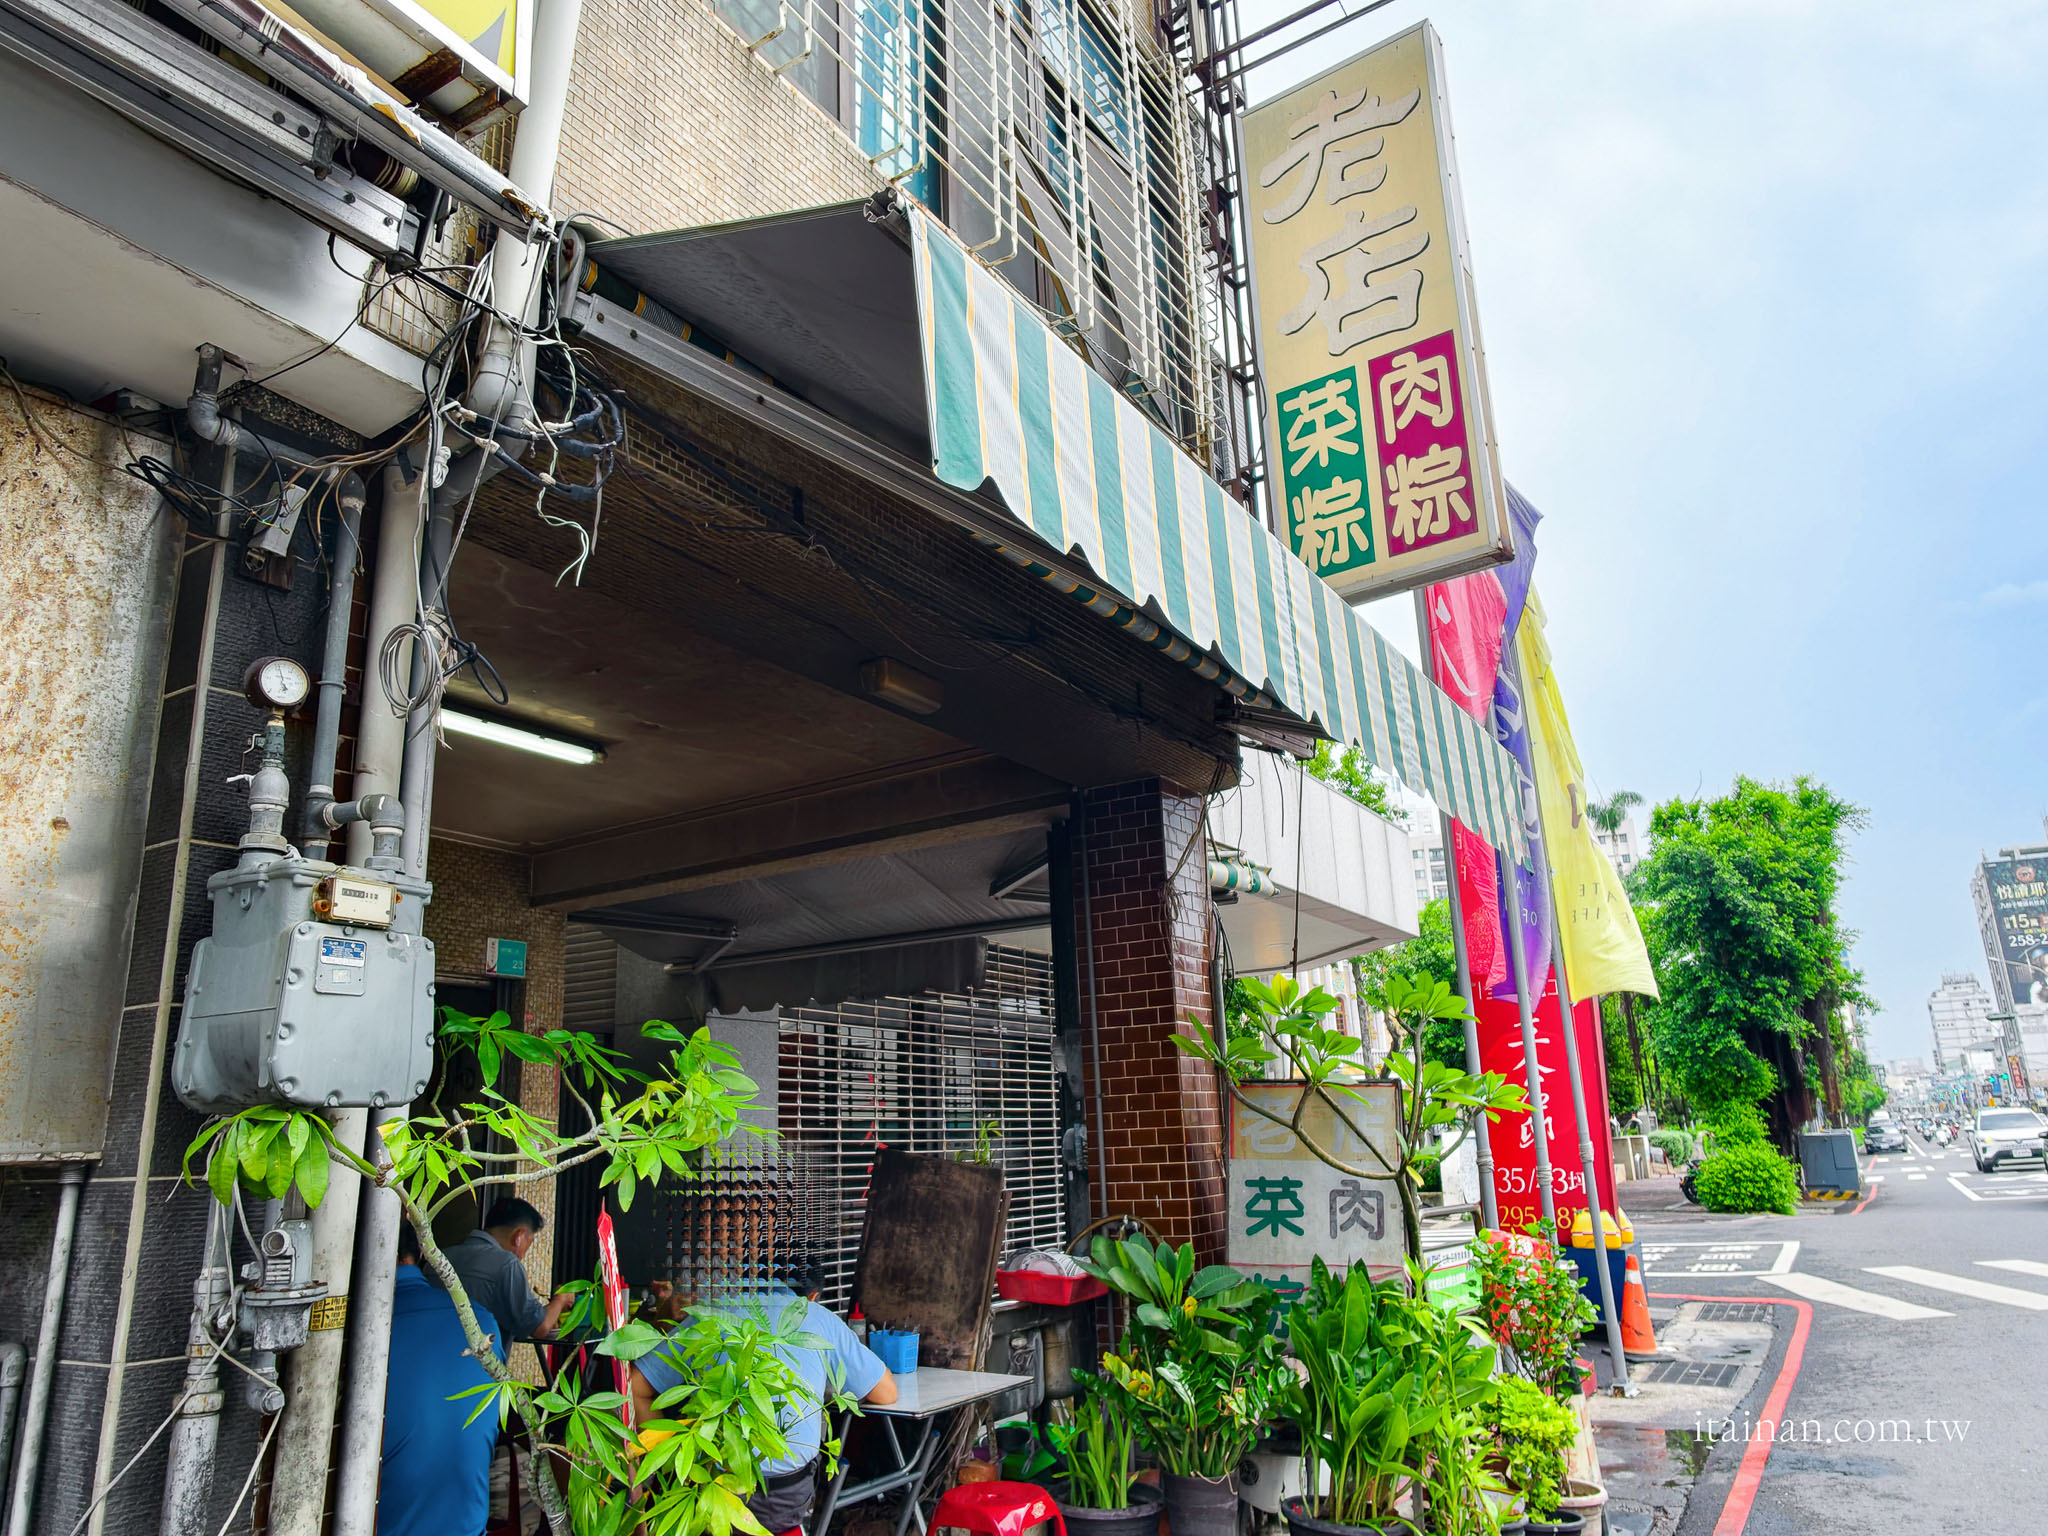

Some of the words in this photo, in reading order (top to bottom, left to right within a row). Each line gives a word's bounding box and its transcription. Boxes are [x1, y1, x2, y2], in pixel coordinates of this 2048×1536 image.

[1260, 86, 1431, 357] 老店
[1282, 378, 1371, 577] 菜粽
[1377, 350, 1472, 546] 肉粽
[2008, 932, 2048, 948] 258-2
[1496, 1166, 1587, 1195] 35/3坪
